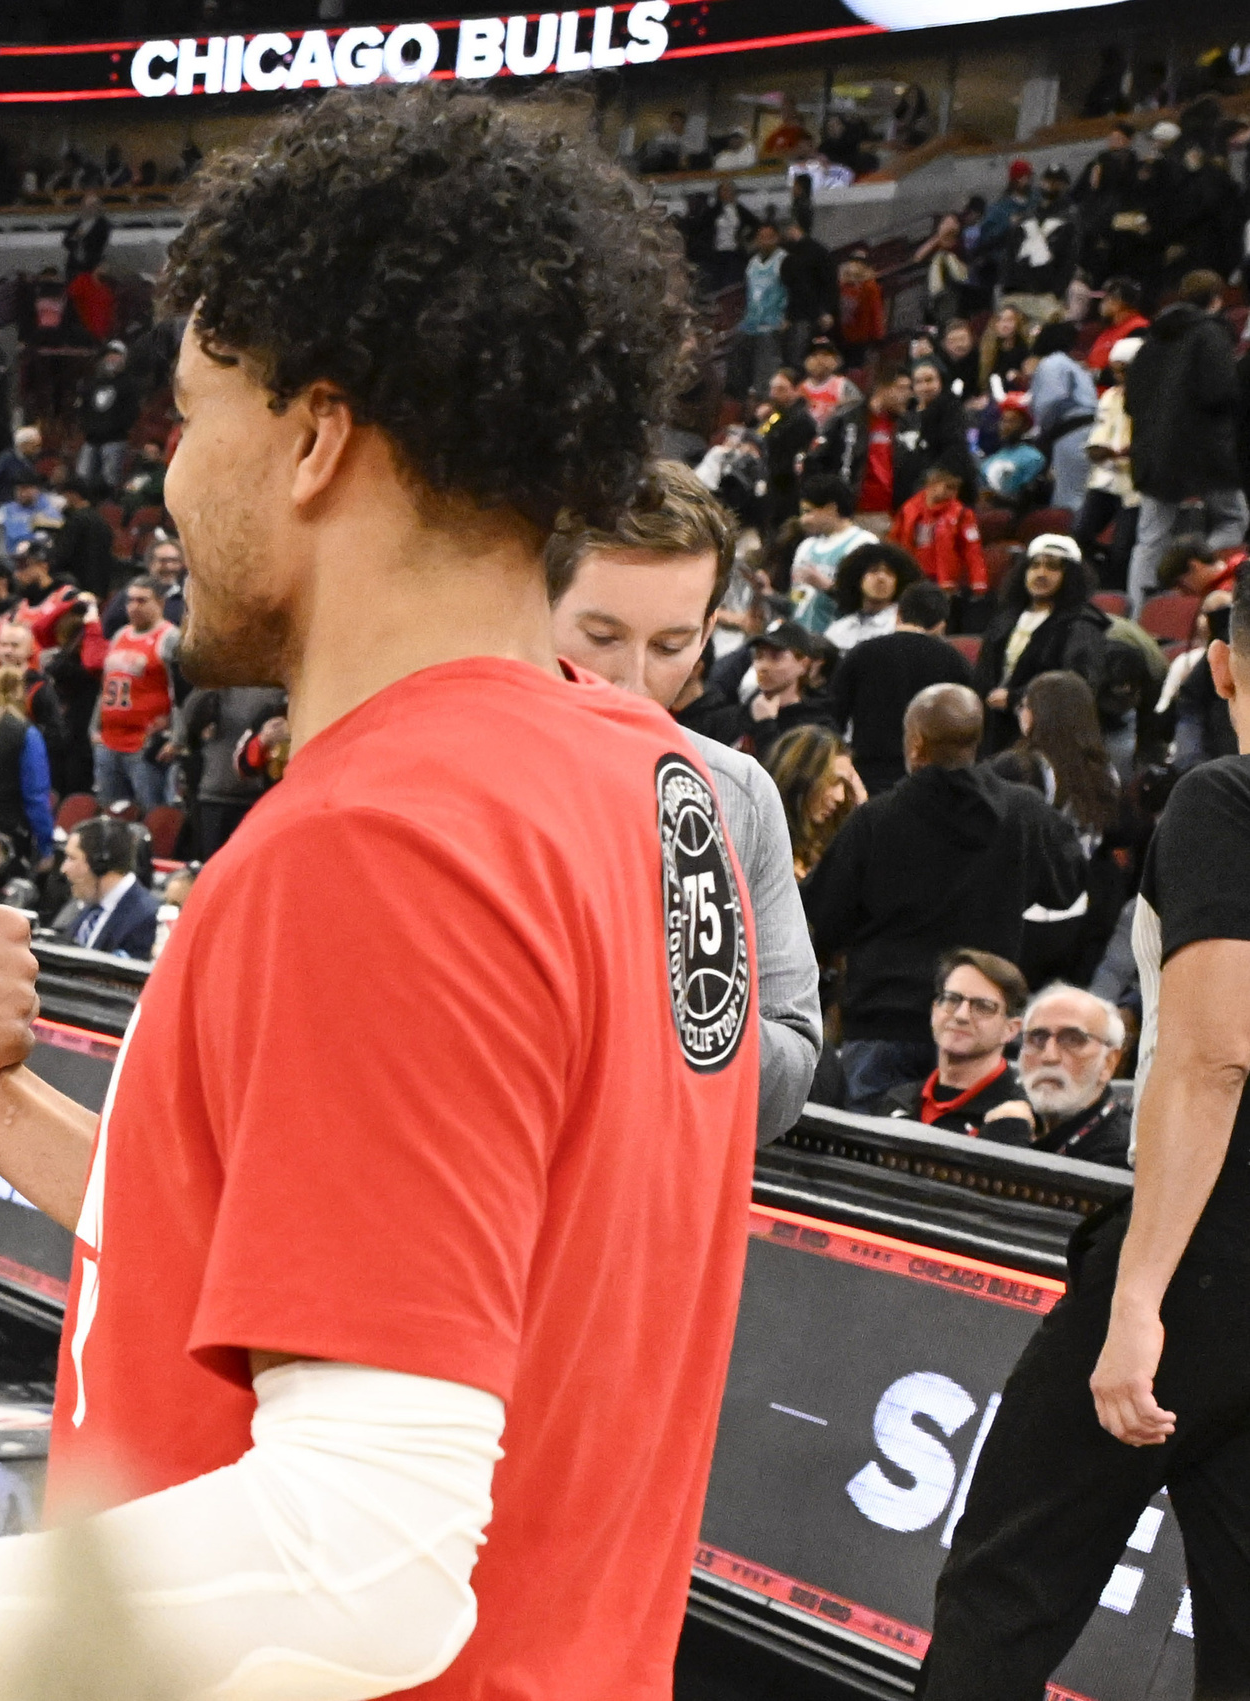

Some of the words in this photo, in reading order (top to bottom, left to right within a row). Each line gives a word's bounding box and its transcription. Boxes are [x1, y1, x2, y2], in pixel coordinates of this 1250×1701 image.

[131, 22, 440, 97] CHICAGO
[455, 2, 670, 80] BULLS
[682, 870, 723, 960] 75
